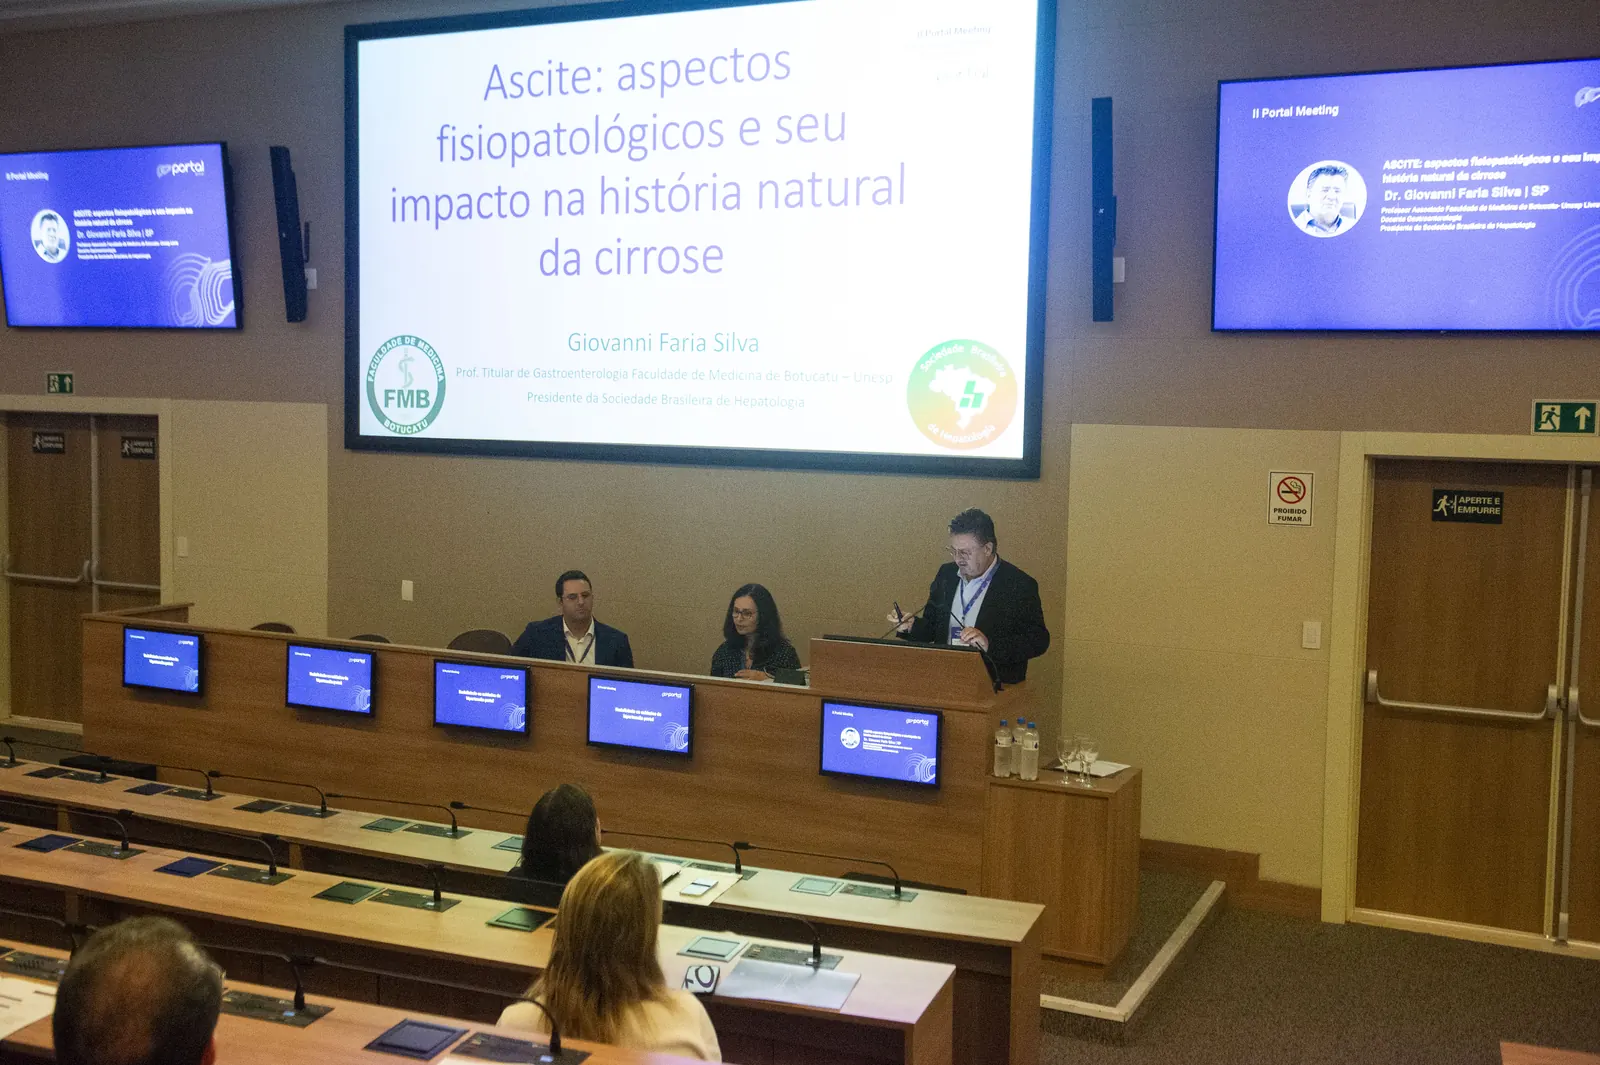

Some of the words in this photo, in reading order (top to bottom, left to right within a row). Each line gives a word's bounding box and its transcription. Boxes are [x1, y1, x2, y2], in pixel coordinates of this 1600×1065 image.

[925, 28, 952, 37] Portal
[954, 25, 992, 35] Meeting
[484, 60, 602, 100] Ascite:
[617, 47, 791, 98] aspectos
[1252, 108, 1259, 118] II
[1262, 106, 1293, 118] Portal
[1296, 104, 1339, 117] Meeting
[436, 113, 724, 168] fisiopatológicos
[740, 116, 761, 146] e
[775, 112, 846, 144] seu
[172, 160, 204, 176] portal
[1383, 159, 1422, 170] ASCITE:
[392, 186, 530, 230] impacto
[544, 187, 584, 217] na
[600, 172, 741, 215] história
[758, 162, 905, 210] natural
[1384, 190, 1401, 201] Dr.
[1404, 188, 1456, 200] Giovanni
[1458, 187, 1489, 199] Faria
[1491, 186, 1522, 197] Silva
[1531, 185, 1550, 196] SP
[539, 238, 581, 276] da
[595, 238, 724, 276] cirrose
[568, 332, 652, 353] Giovanni
[660, 332, 706, 352] Faria
[714, 332, 760, 352] Silva
[368, 337, 402, 382] FACULDADE
[404, 336, 416, 345] DE
[417, 340, 444, 382] MEDICINA
[920, 344, 964, 372] Sociedade
[455, 366, 479, 379] Prof.
[482, 366, 514, 378] Titular
[517, 366, 530, 379] de
[533, 366, 628, 382] Gastroenterologia
[632, 368, 688, 381] Faculdade
[691, 368, 706, 381] de
[709, 369, 762, 382] Medicina
[765, 369, 780, 382] de
[785, 370, 838, 383] Botucatu
[854, 371, 892, 385] Unesp
[384, 389, 430, 408] FMB
[527, 391, 583, 404] Presidente
[586, 392, 599, 404] da
[602, 392, 658, 405] Sociedade
[661, 392, 713, 406] Brasileira
[716, 393, 730, 406] de
[734, 394, 805, 409] Hepatologia
[384, 419, 428, 434] BOTUCATU
[1459, 496, 1492, 505] APERTE
[1494, 497, 1500, 505] E
[1457, 506, 1500, 515] EMPURRE
